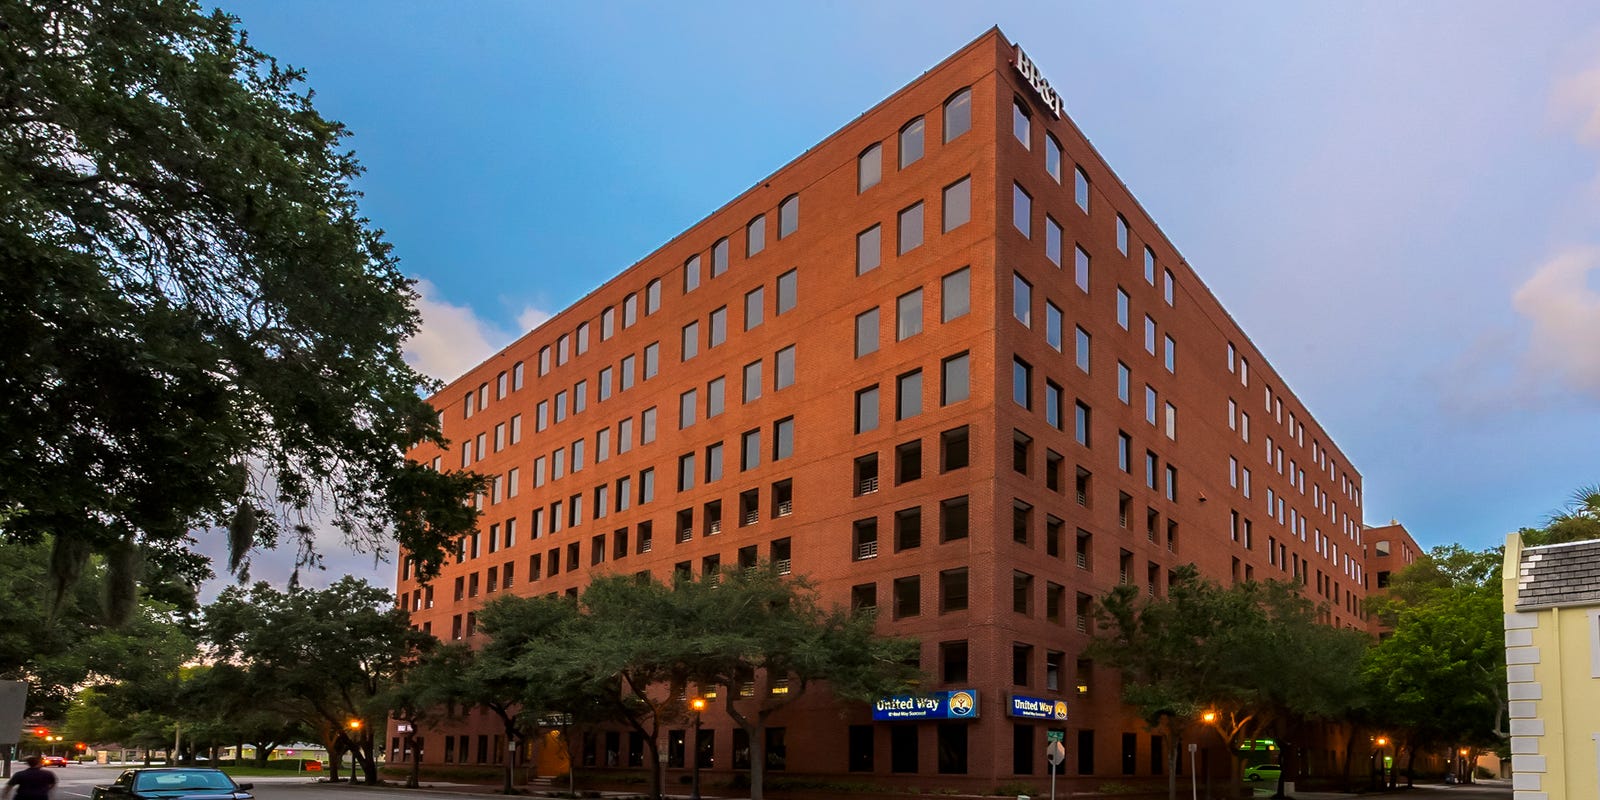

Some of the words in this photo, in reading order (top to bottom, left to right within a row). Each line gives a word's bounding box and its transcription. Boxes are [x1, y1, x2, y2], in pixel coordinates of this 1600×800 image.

[1015, 44, 1064, 119] BB&T
[876, 698, 914, 711] United
[916, 698, 939, 711] Way
[1014, 699, 1038, 711] United
[1039, 701, 1053, 715] Way
